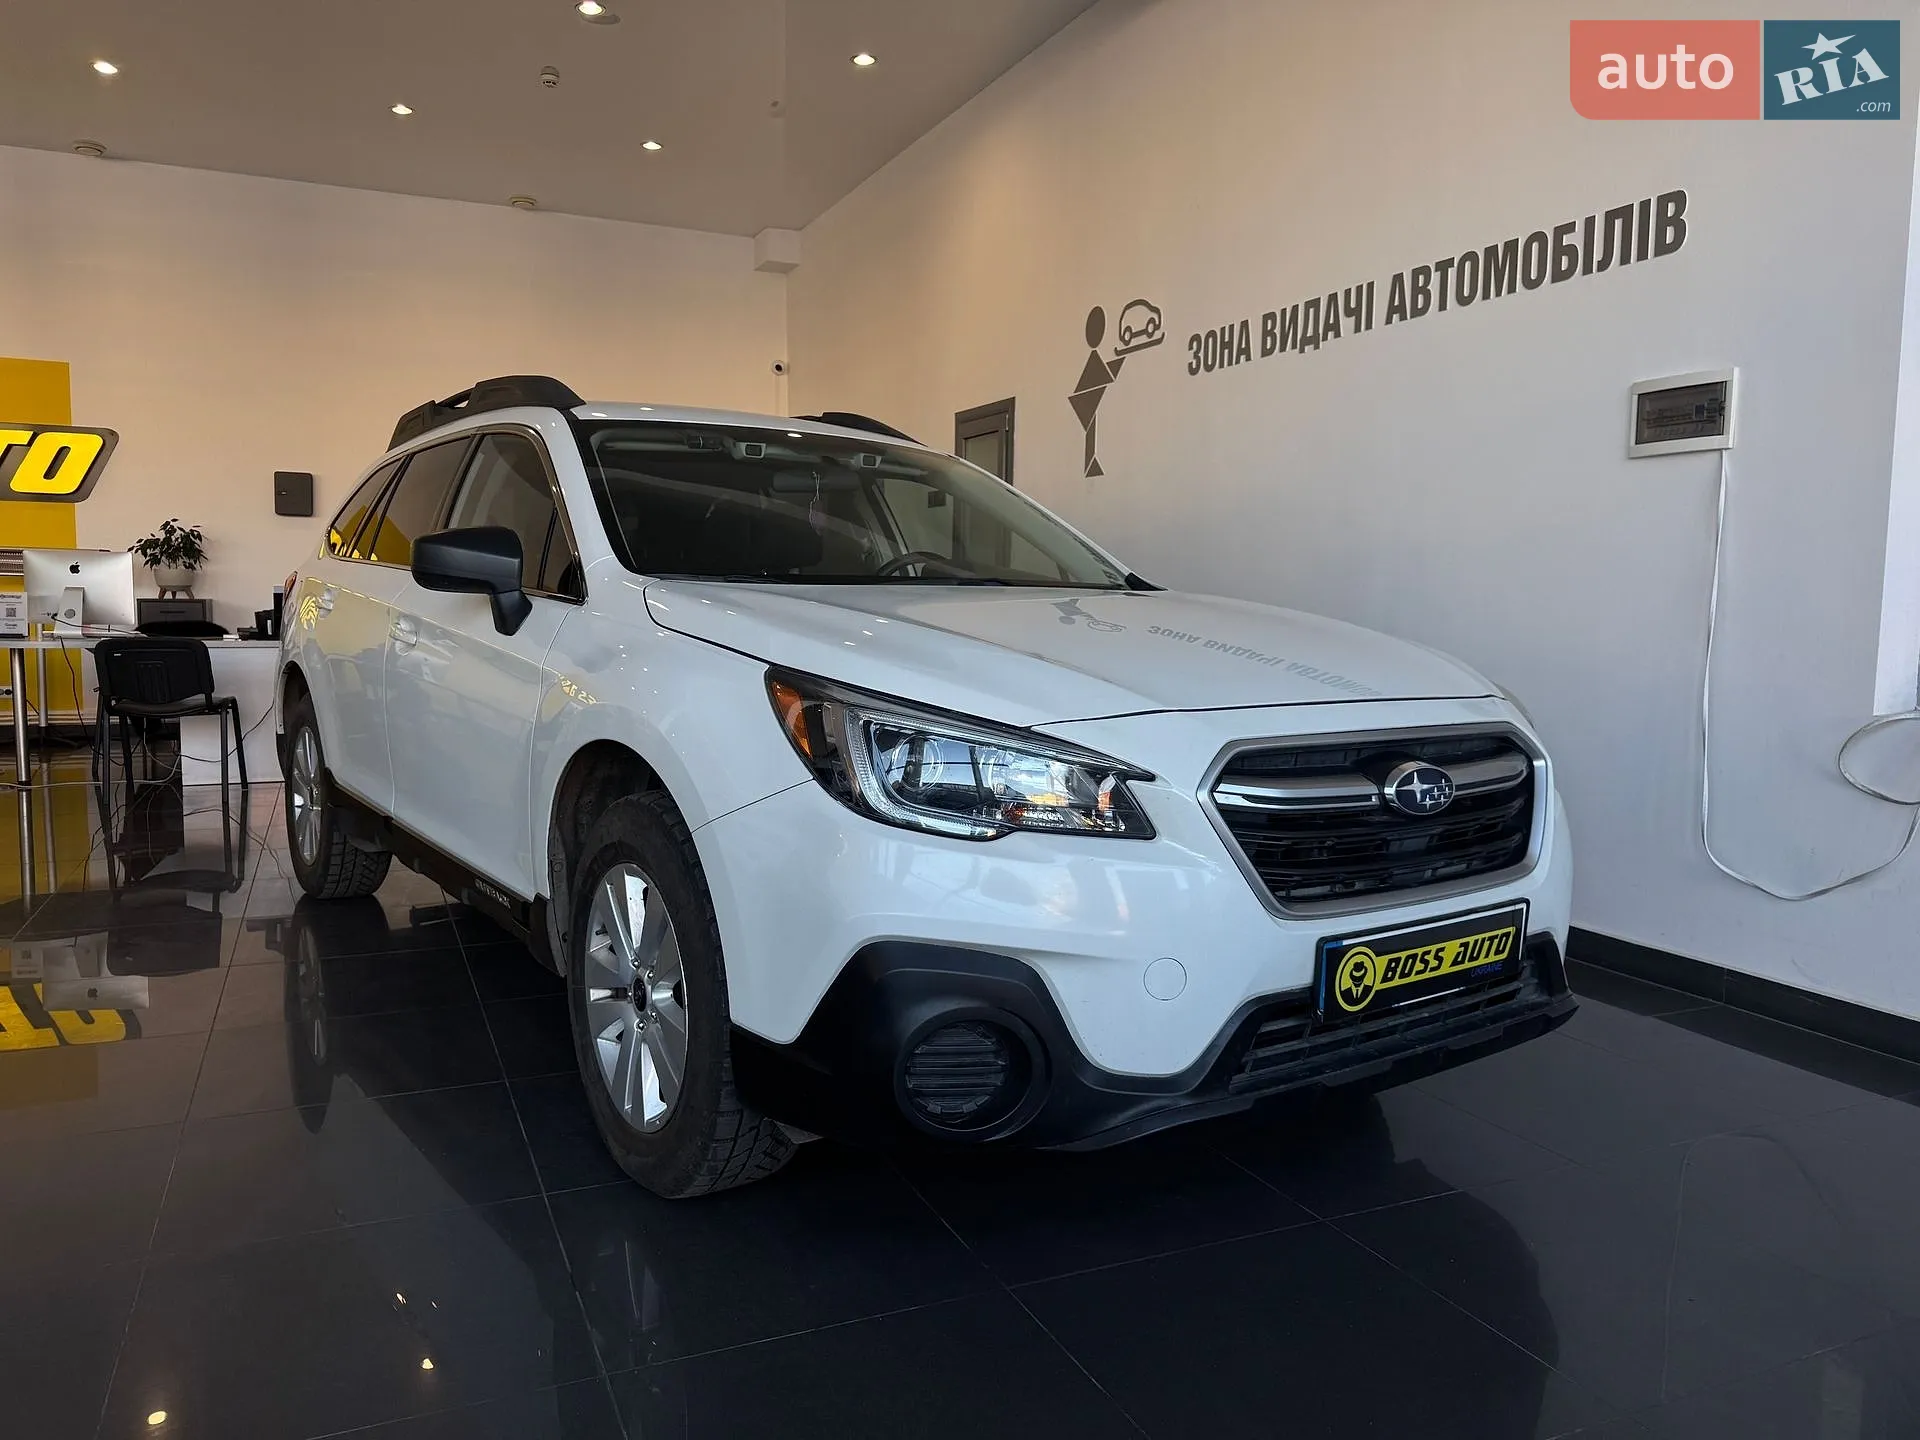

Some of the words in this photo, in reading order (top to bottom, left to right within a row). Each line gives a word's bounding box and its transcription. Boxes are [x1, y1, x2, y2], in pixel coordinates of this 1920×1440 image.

[1187, 319, 1252, 376] ЗОНА
[1260, 280, 1375, 358] ВИДАЧІ
[1384, 189, 1688, 326] АВТОМОБІЛІВ
[1380, 946, 1446, 984] BOSS
[1449, 930, 1512, 968] AUTO
